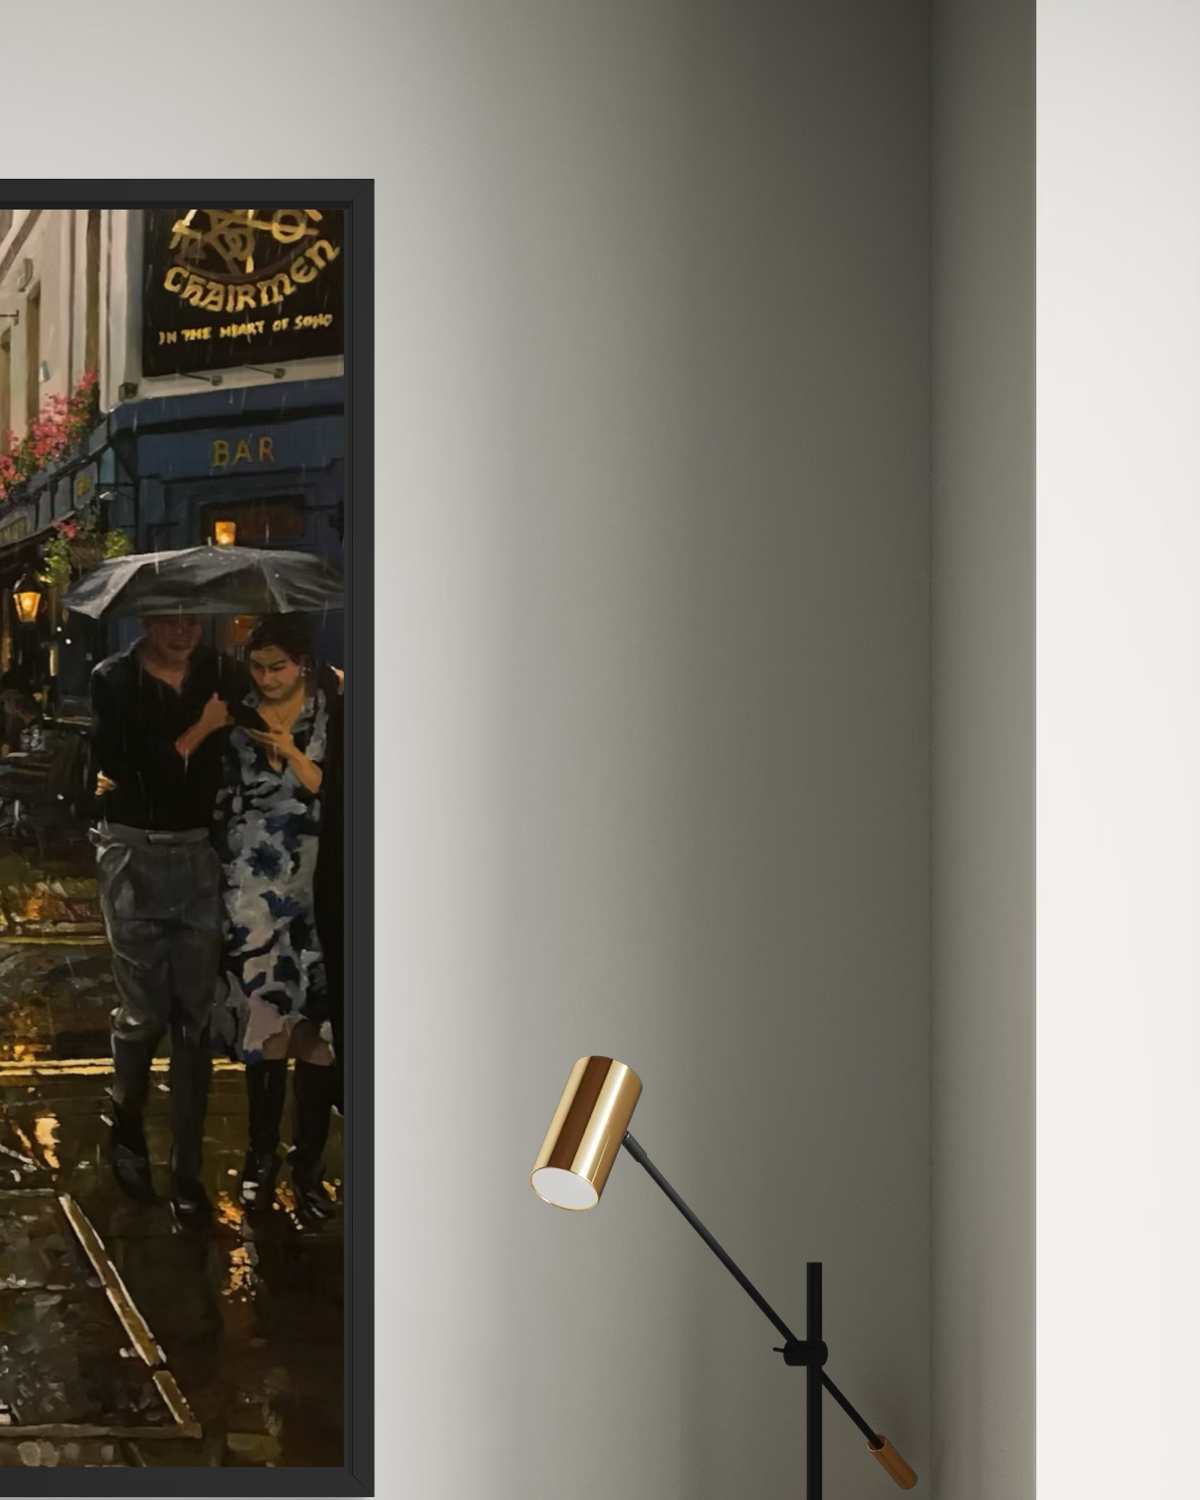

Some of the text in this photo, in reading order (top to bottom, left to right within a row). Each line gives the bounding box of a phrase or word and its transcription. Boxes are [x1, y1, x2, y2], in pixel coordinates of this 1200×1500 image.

[158, 313, 333, 345] IN THE HEART OF SOHO
[211, 436, 275, 468] BAR
